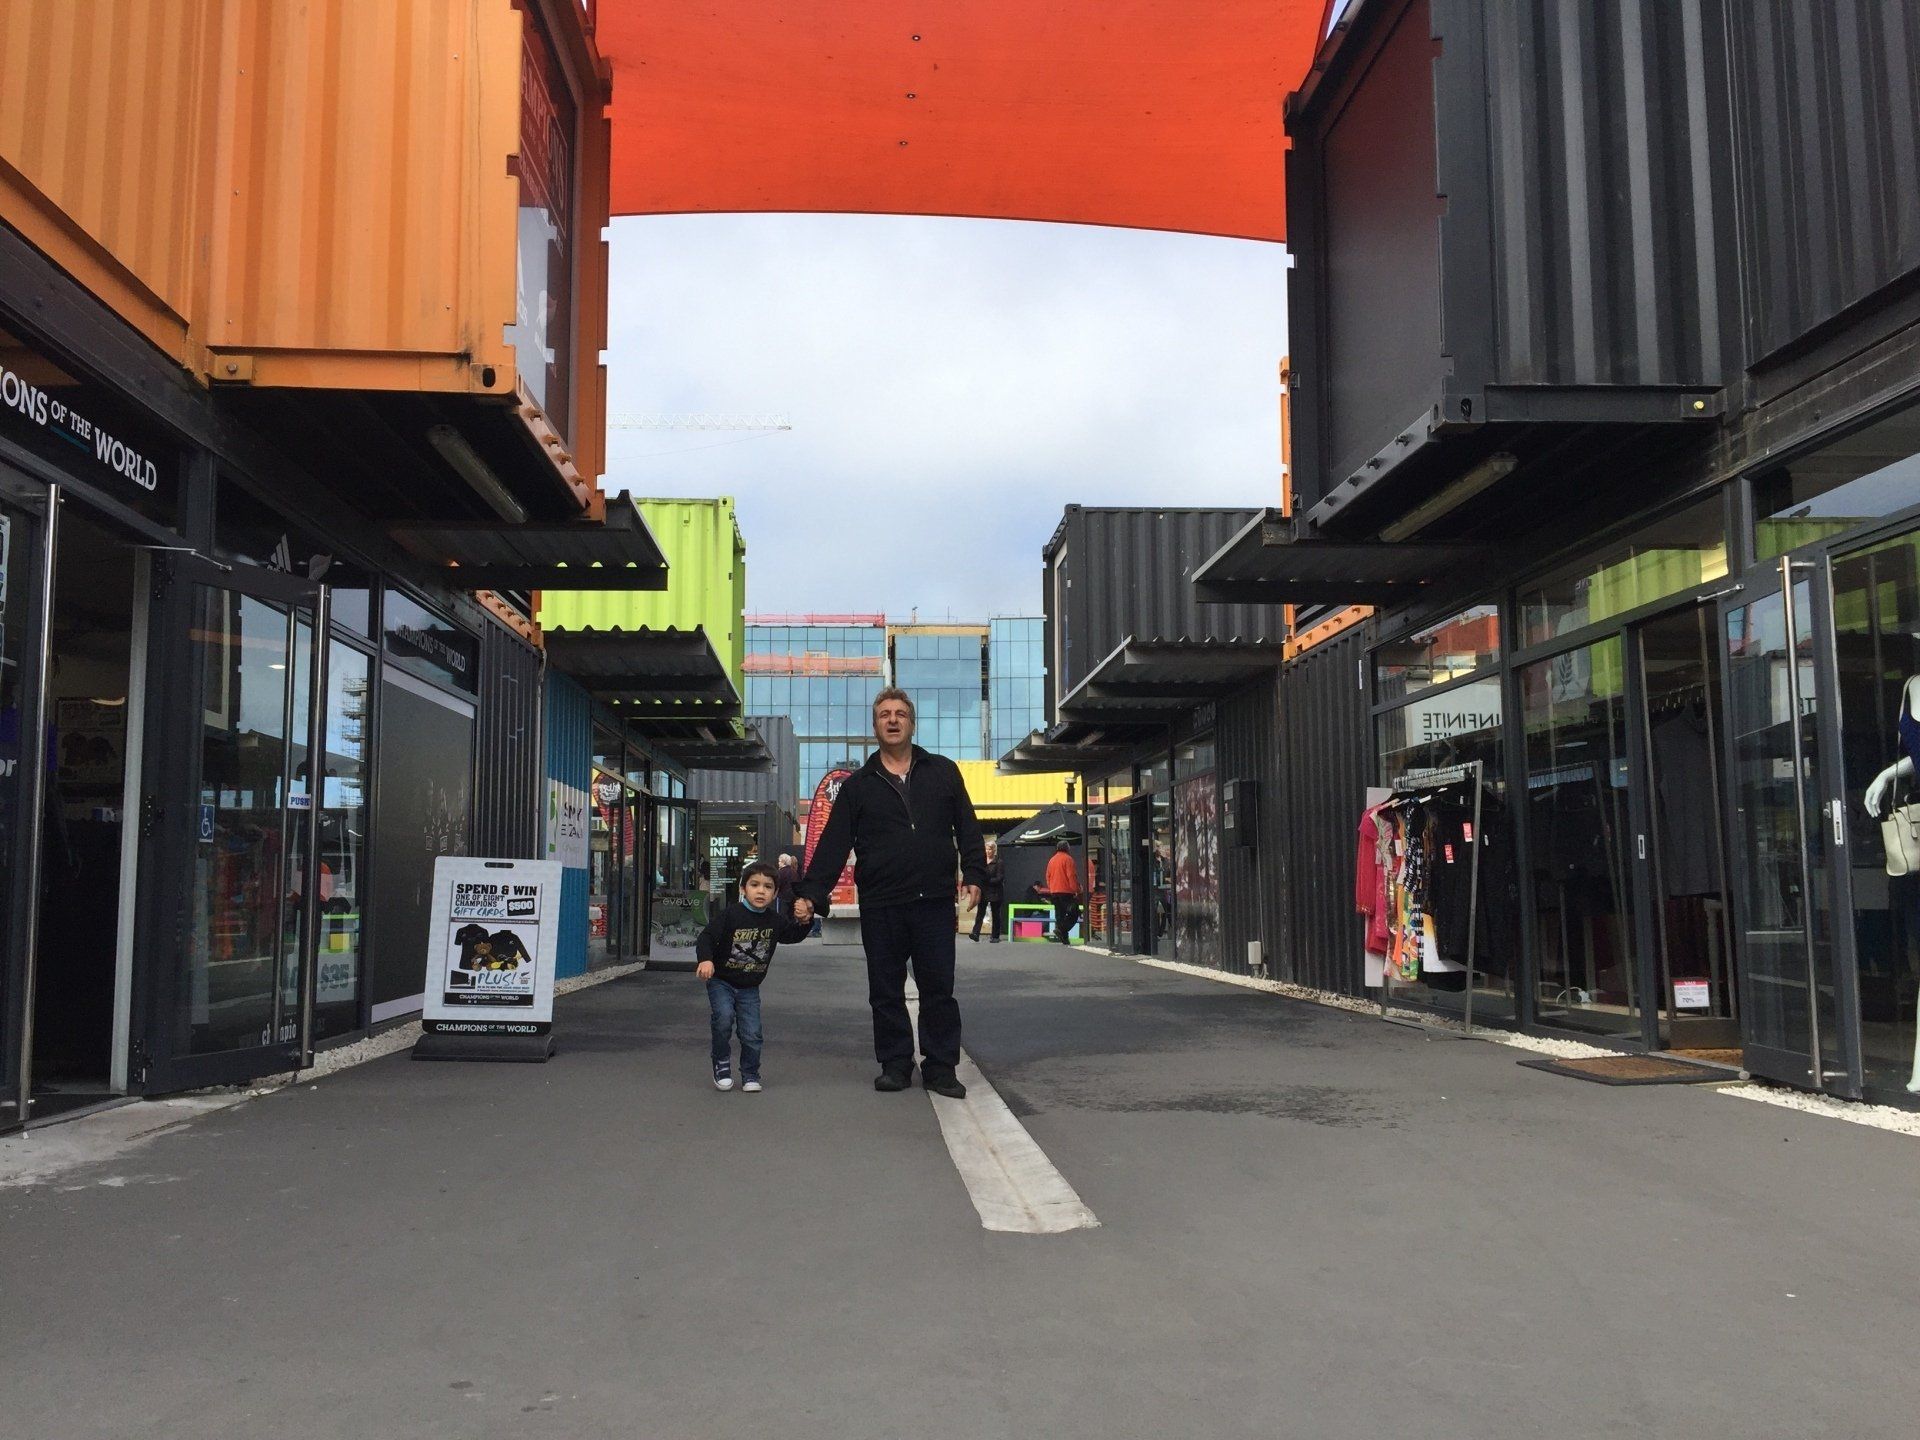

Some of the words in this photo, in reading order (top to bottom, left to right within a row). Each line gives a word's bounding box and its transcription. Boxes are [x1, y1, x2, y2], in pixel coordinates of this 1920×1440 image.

[51, 400, 67, 424] OF
[70, 411, 91, 440] THE
[94, 427, 157, 491] WORLD
[446, 646, 466, 672] WORLD
[710, 836, 730, 846] DEF
[710, 847, 738, 856] INITE
[456, 884, 498, 894] SPEND
[501, 885, 509, 895] &
[513, 886, 537, 896] WIN
[508, 900, 533, 911] $500
[453, 907, 475, 916] GIFT
[476, 908, 505, 917] CARDS
[477, 972, 517, 986] PLUS!
[436, 1023, 488, 1032] CHAMPIONS
[507, 1025, 537, 1033] WORLD
